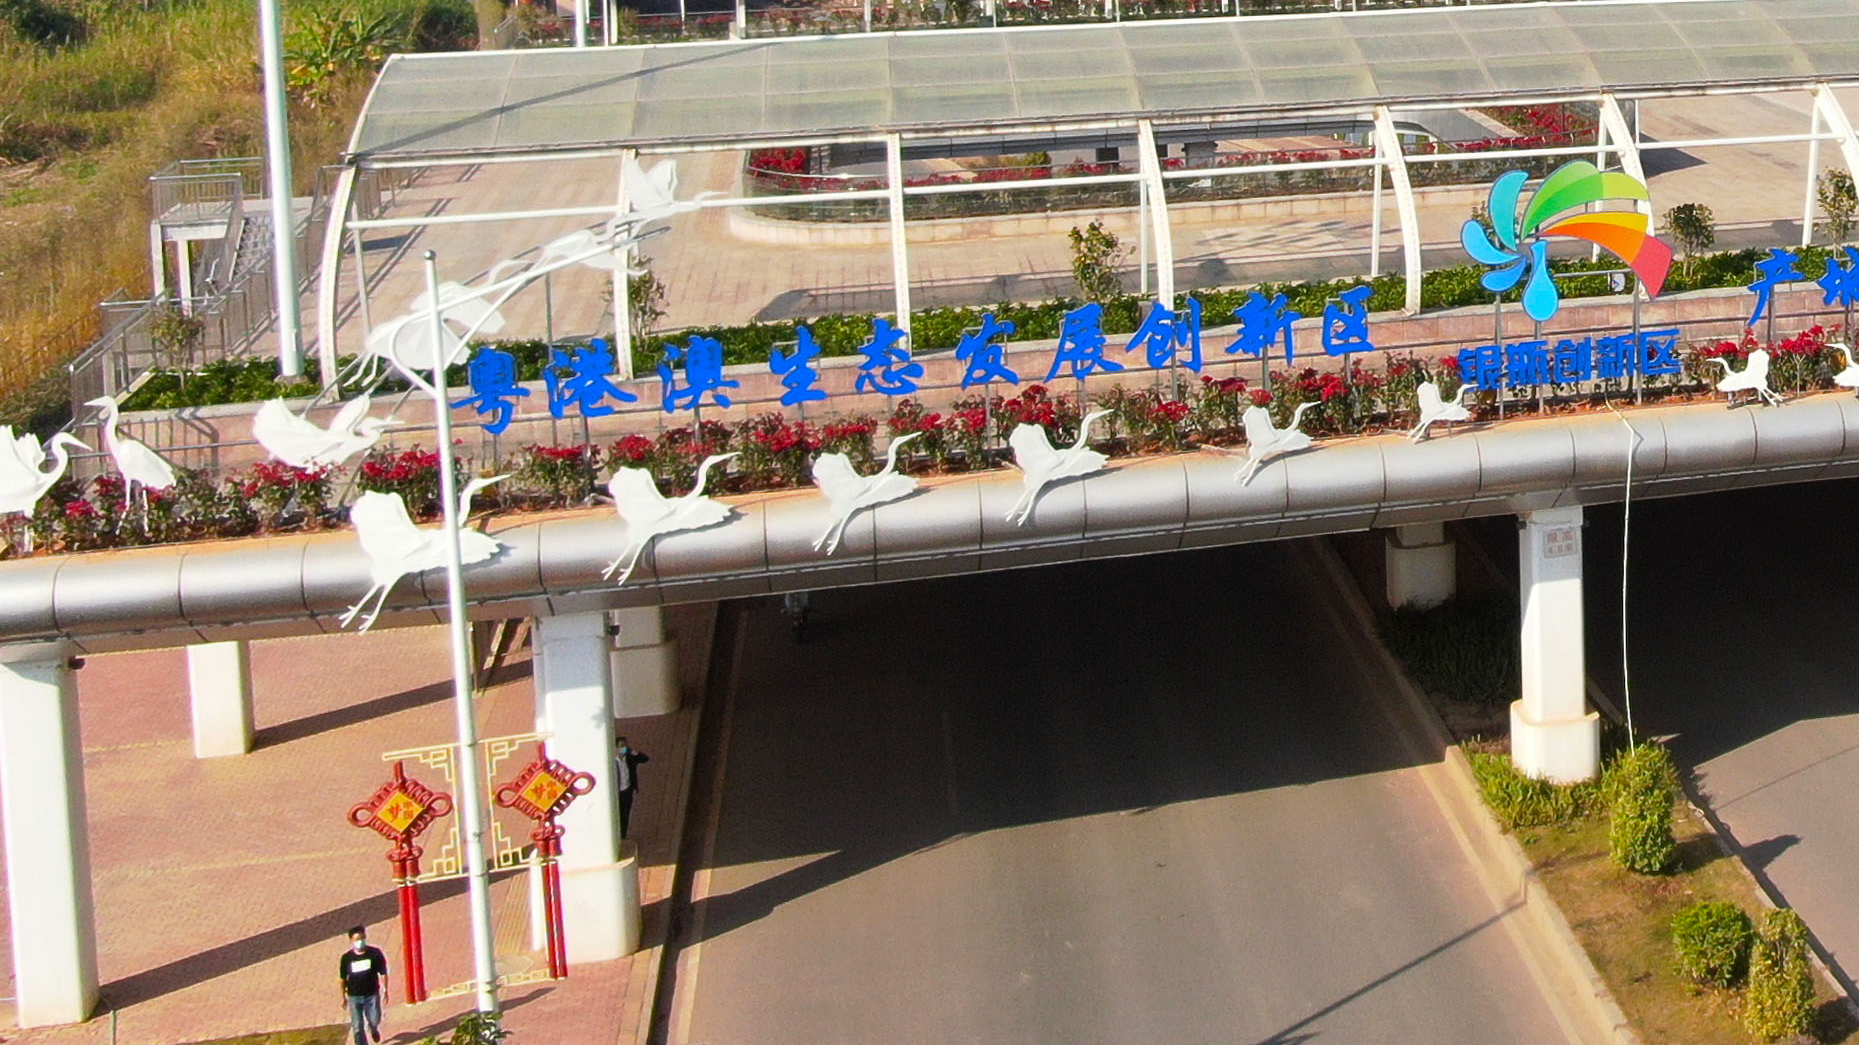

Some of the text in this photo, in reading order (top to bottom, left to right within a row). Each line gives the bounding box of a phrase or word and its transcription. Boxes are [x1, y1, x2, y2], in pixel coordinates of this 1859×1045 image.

[450, 286, 1375, 435] 粤港澳生态发展创新区
[1458, 329, 1681, 392] 银瓶创新区
